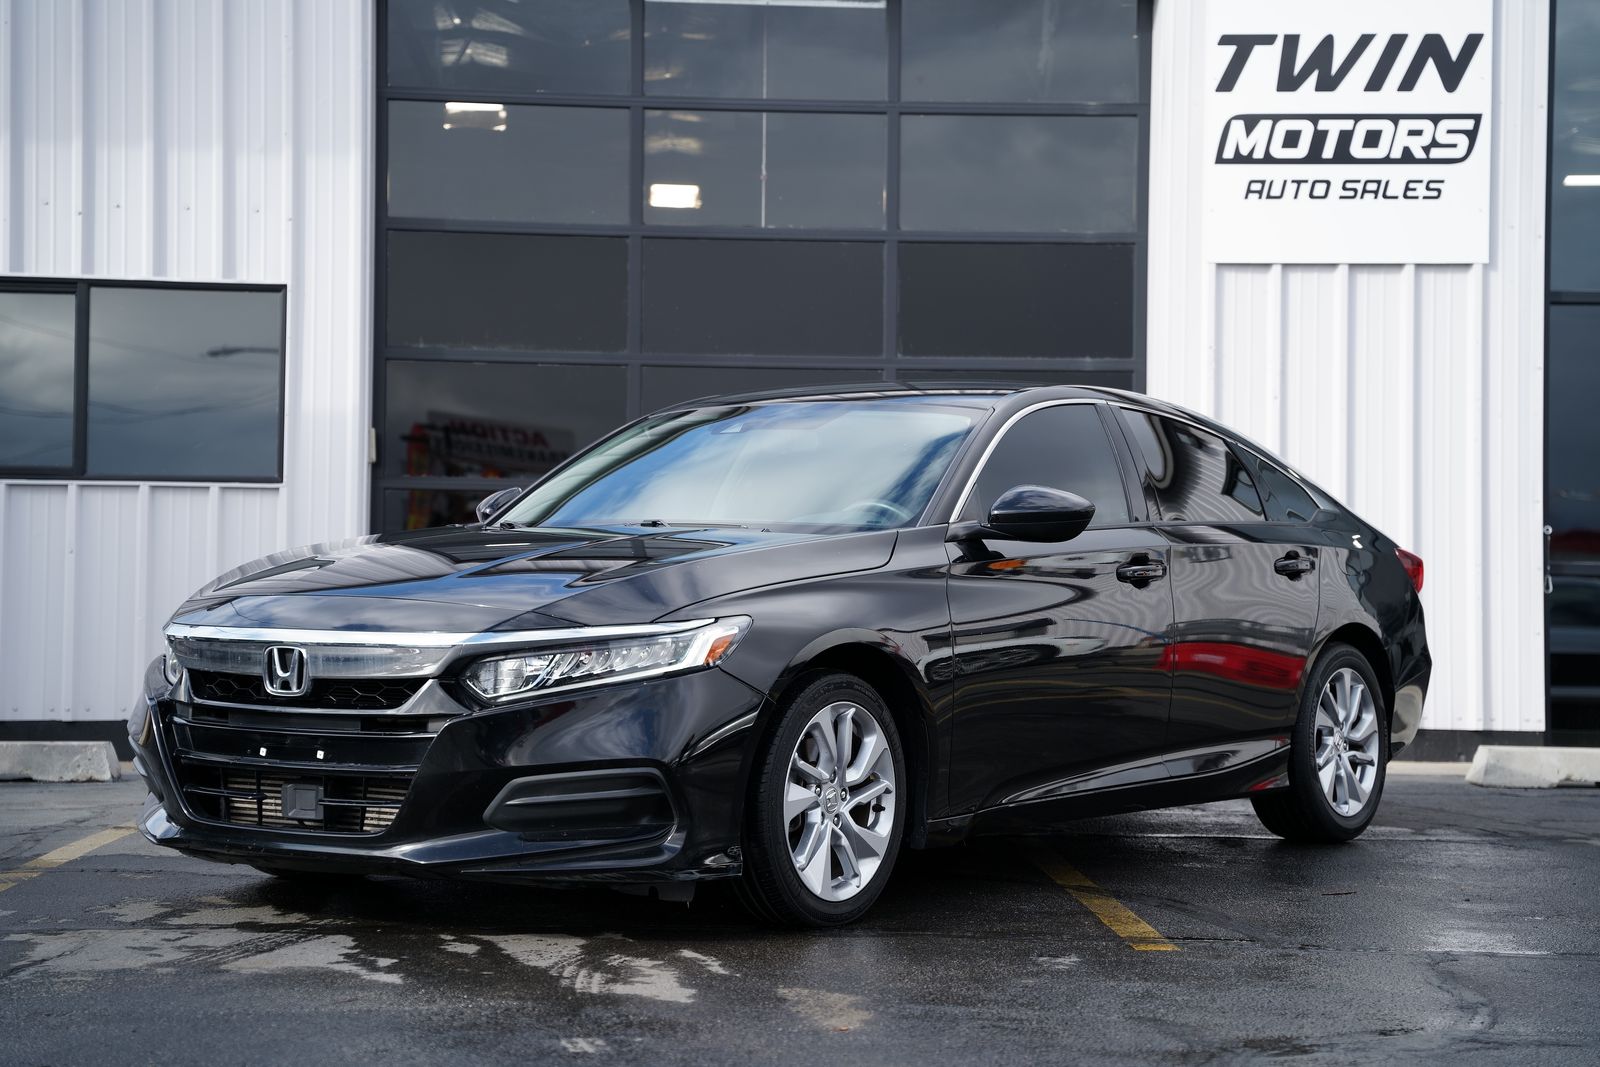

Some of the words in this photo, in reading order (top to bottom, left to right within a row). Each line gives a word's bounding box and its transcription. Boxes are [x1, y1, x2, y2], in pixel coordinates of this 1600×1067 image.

[1215, 33, 1485, 94] TWIN
[1221, 118, 1476, 160] MOTORS
[1244, 179, 1332, 200] AUTO
[1338, 179, 1445, 200] SALES
